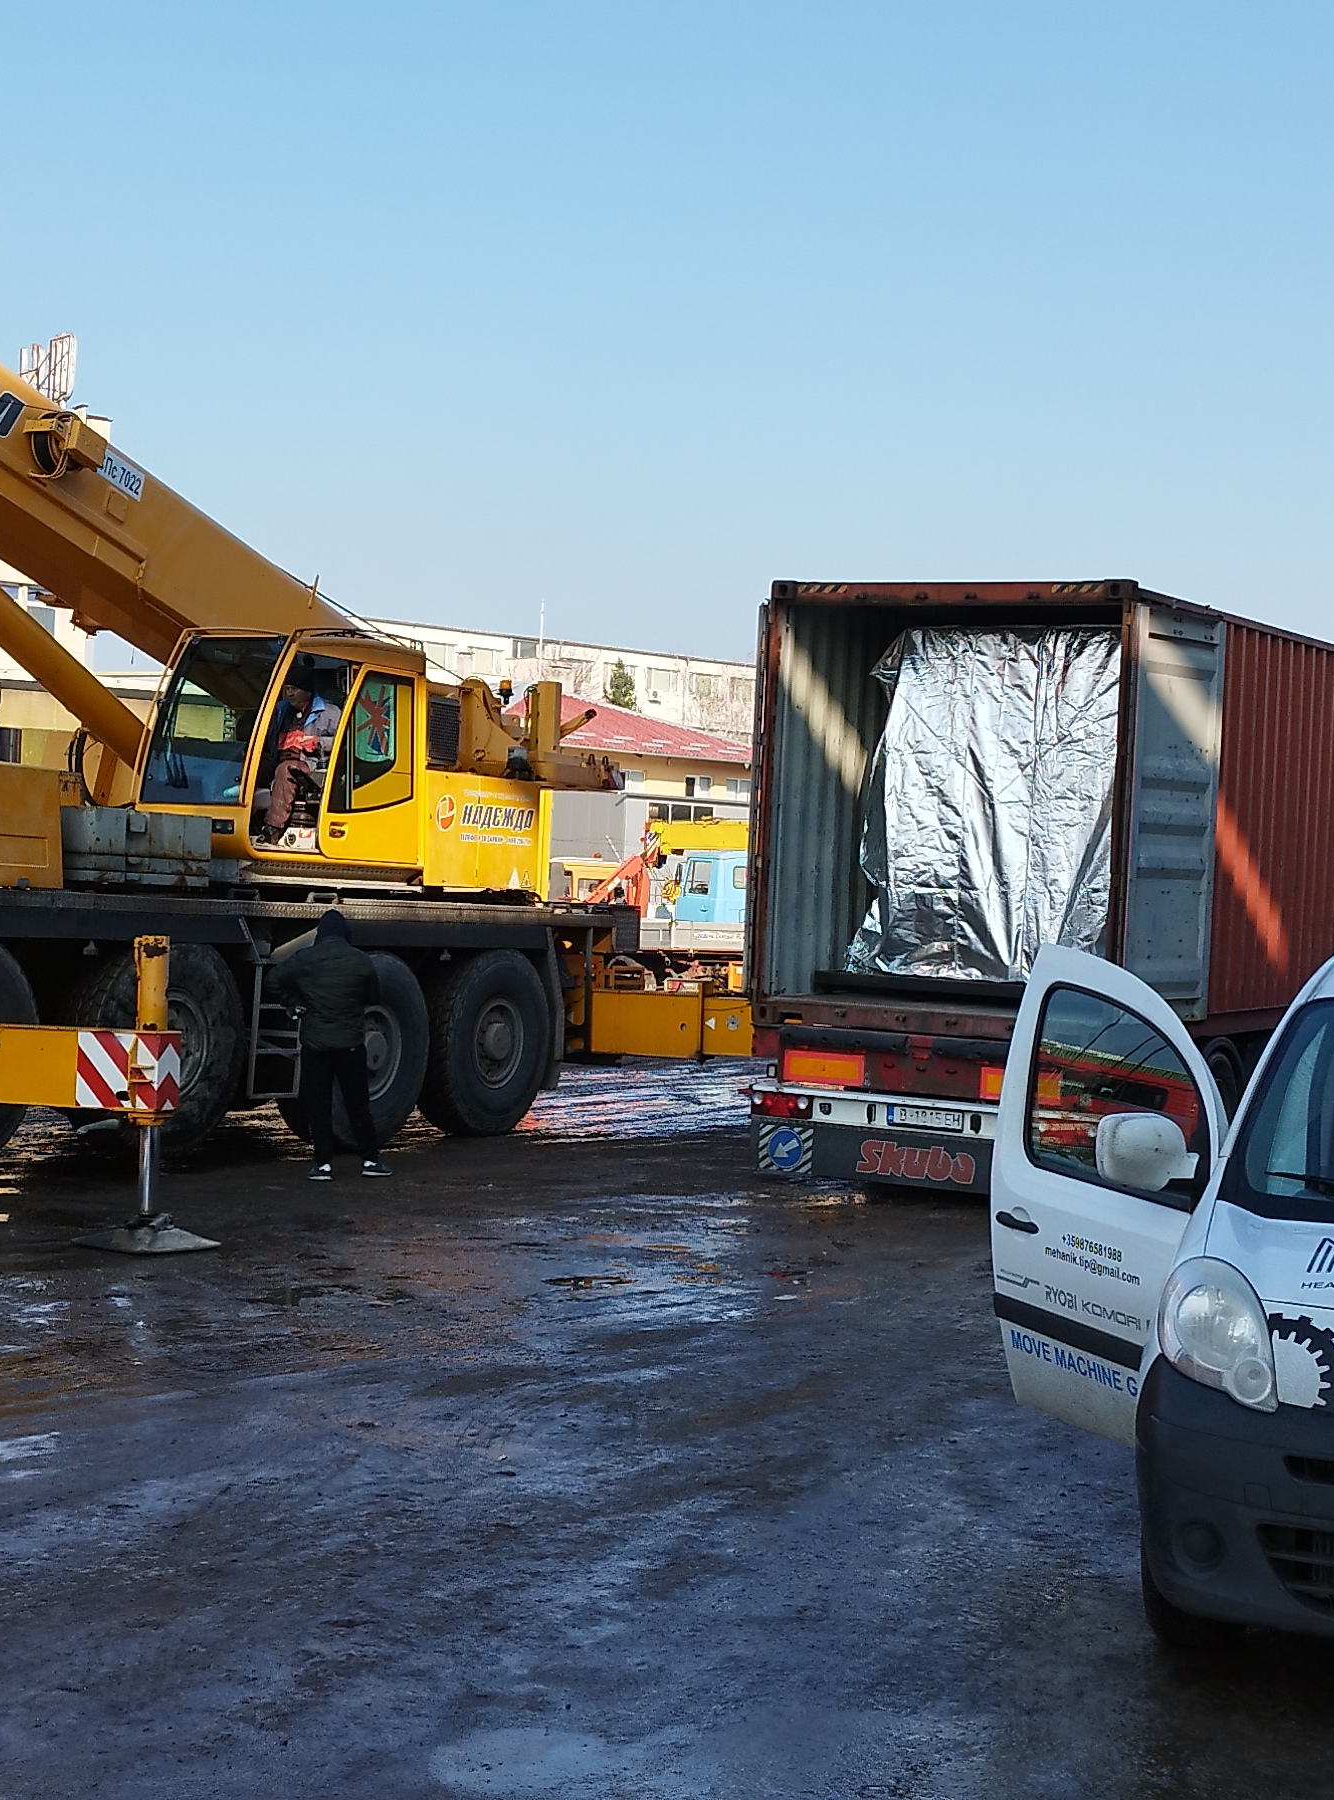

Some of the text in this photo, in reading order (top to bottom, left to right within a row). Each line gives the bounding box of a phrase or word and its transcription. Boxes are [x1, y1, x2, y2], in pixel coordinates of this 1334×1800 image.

[118, 466, 142, 496] 7022
[460, 804, 535, 833] НАДЕЖДА
[855, 1139, 976, 1184] Skuba
[1045, 1246, 1141, 1286] mehanik.tip@gmail.com
[1044, 1284, 1078, 1312] RYOBI
[1081, 1299, 1142, 1332] KOMORI
[1010, 1329, 1052, 1363] MOVE
[1054, 1346, 1124, 1392] MACHINE
